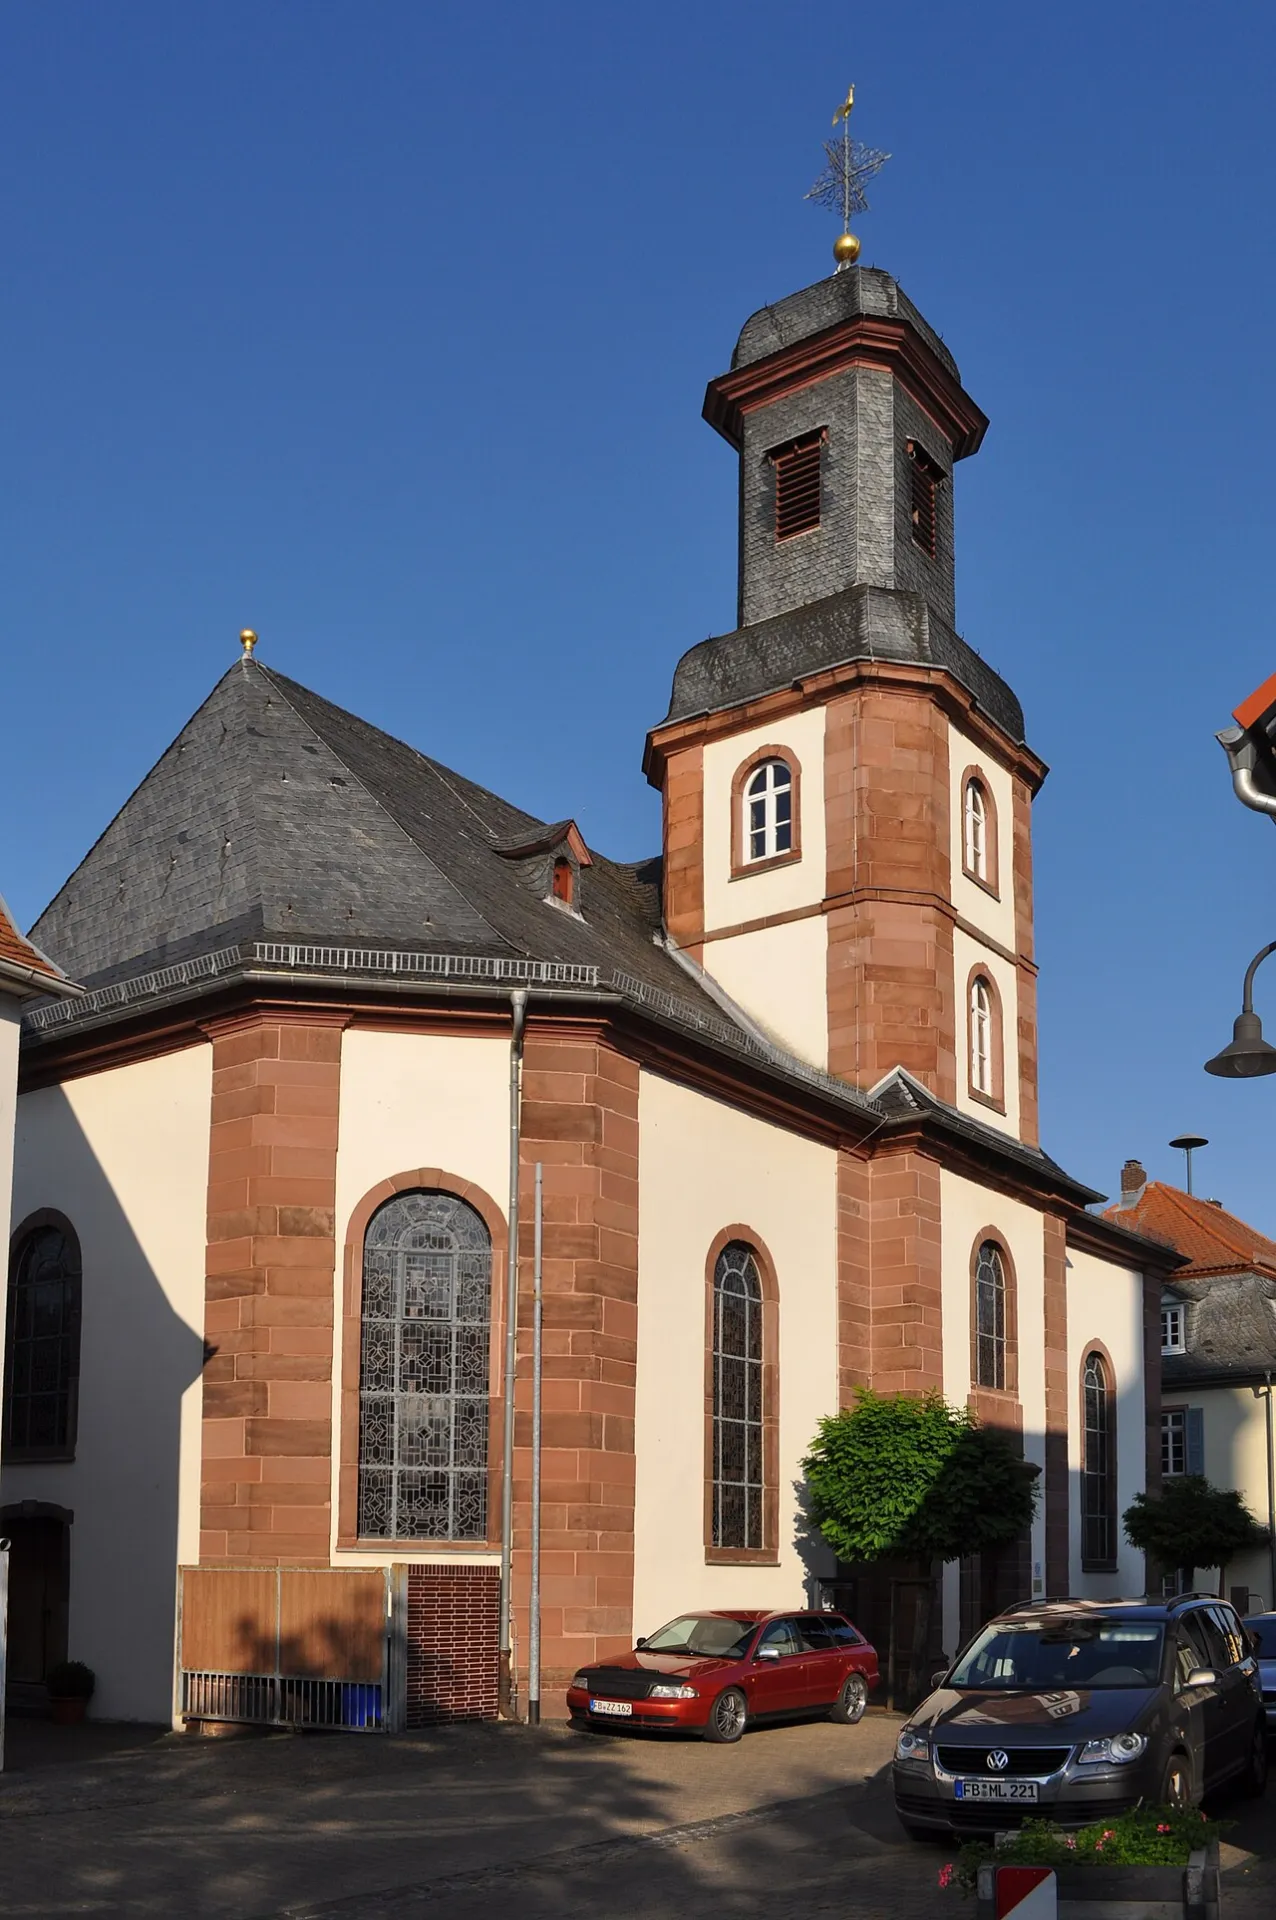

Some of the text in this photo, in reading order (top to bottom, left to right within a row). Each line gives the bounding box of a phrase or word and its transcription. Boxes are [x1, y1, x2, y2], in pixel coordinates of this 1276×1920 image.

[593, 1701, 631, 1713] FB ZZ 162
[987, 1750, 1008, 1770] VW
[963, 1783, 1036, 1798] FB ML 221
